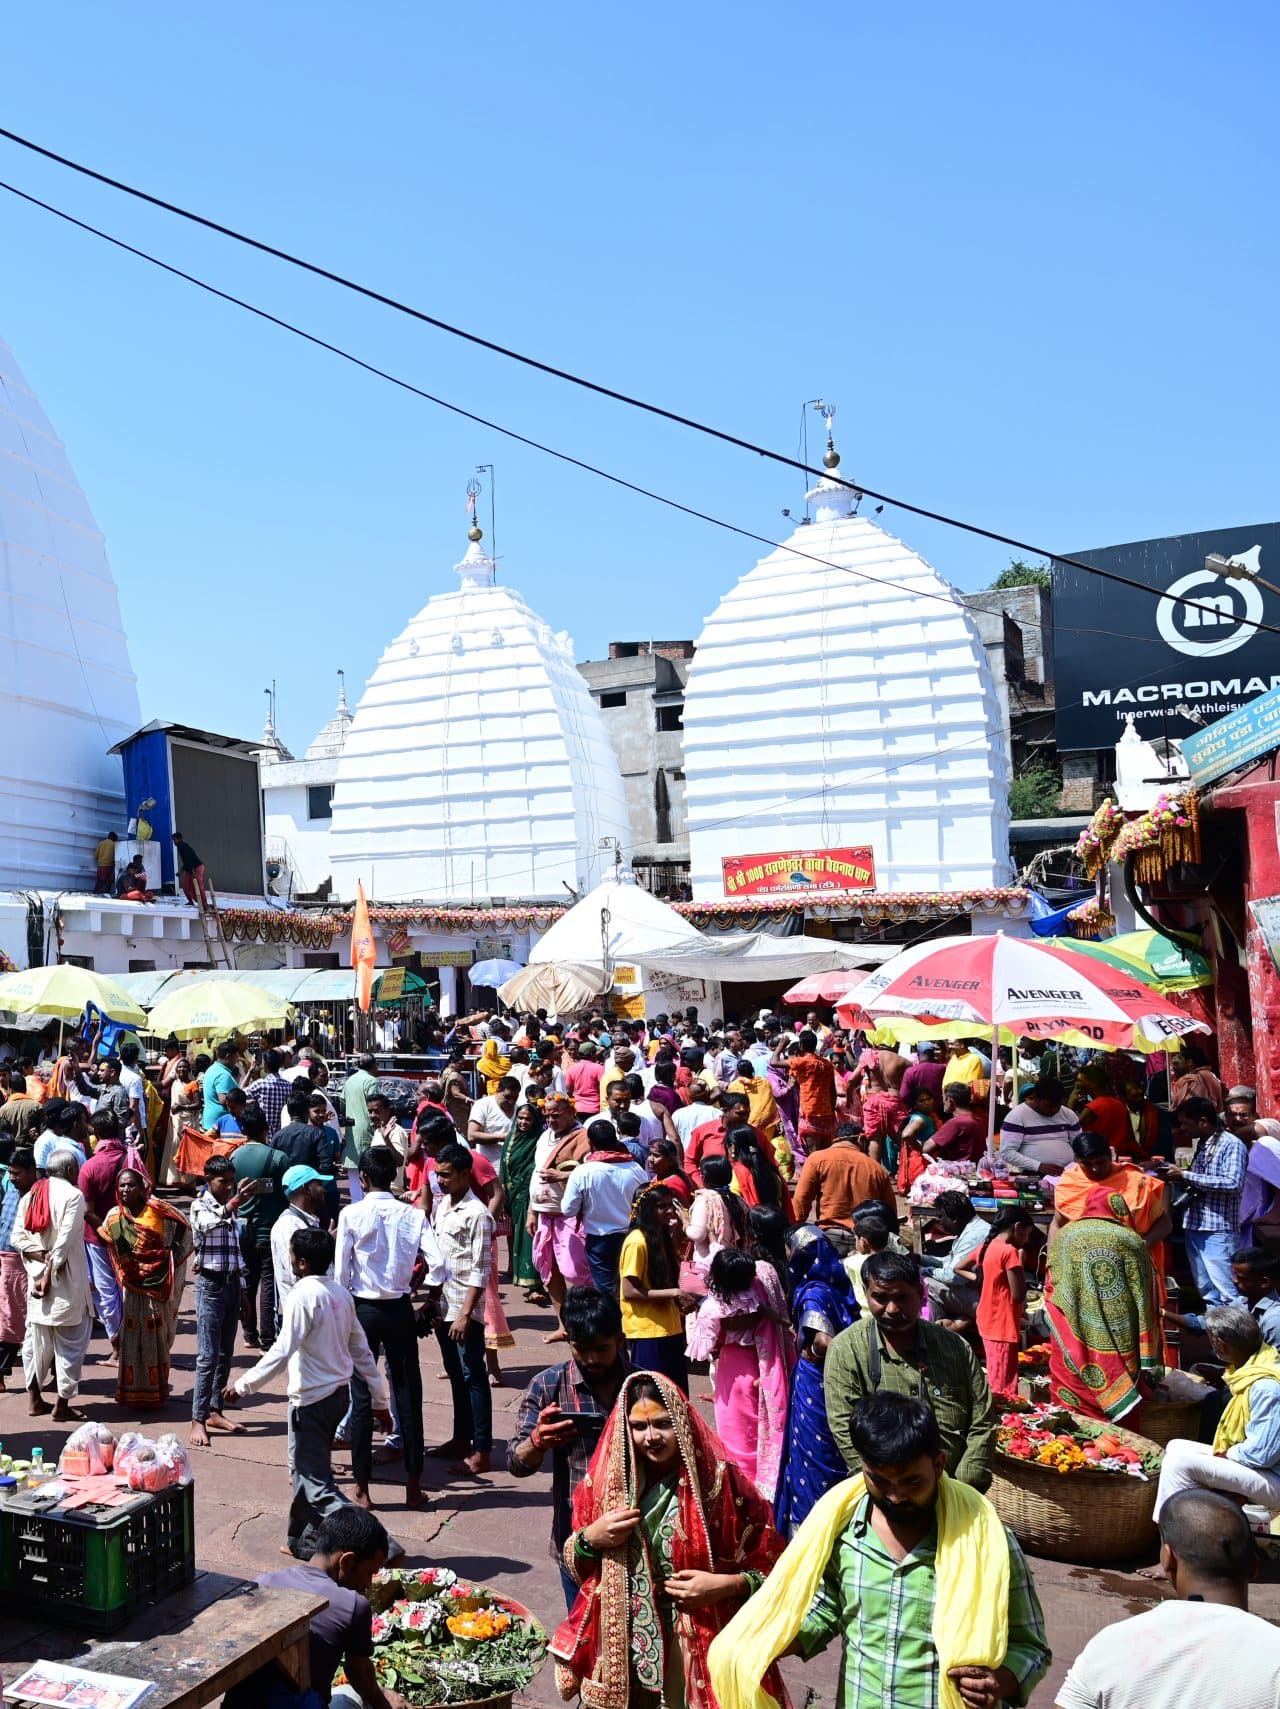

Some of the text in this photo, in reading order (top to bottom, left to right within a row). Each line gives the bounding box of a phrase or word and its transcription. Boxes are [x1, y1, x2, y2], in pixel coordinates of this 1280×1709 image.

[1193, 701, 1249, 714] Athleisu
[805, 858, 825, 872] बाबा
[908, 975, 980, 990] AVENGER
[1007, 987, 1083, 1000] AVENGER
[1025, 1018, 1104, 1040] PLYWOD
